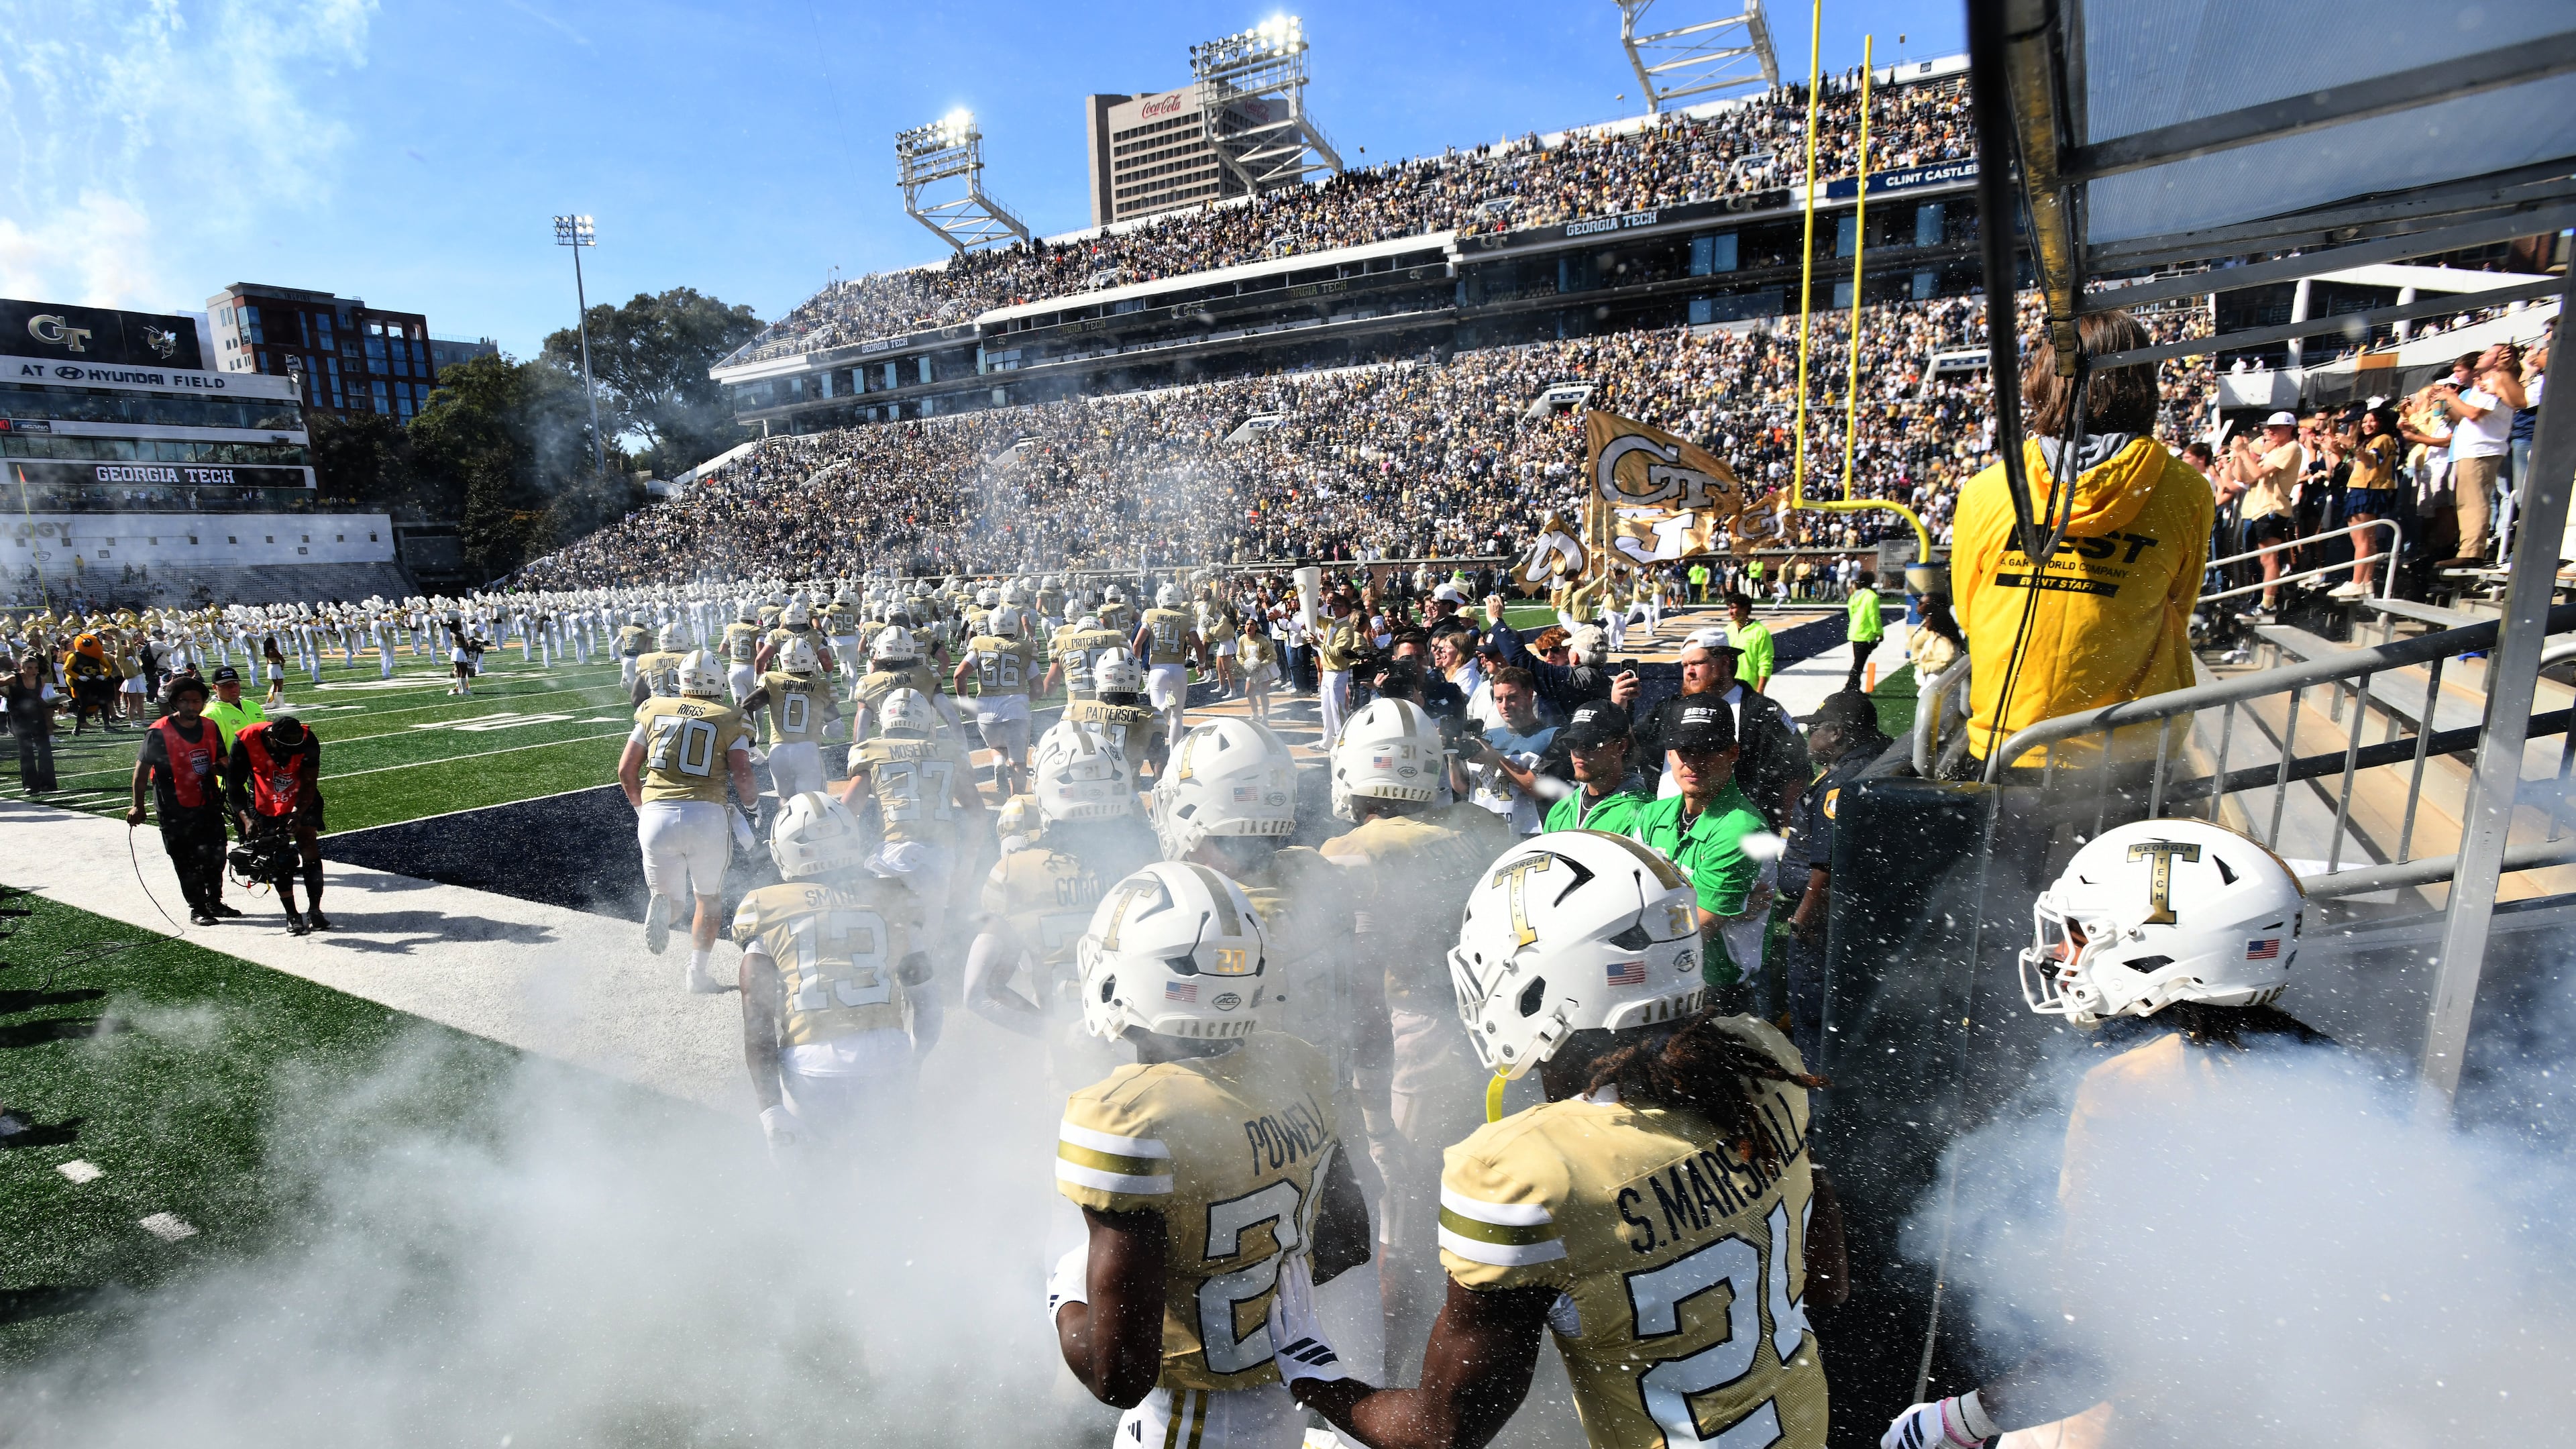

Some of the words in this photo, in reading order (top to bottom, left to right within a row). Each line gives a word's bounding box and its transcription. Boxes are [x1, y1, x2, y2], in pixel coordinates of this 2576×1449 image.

[1886, 172, 1922, 187] CLINT
[1566, 217, 1619, 237] GEORGIA
[1623, 211, 1658, 228] TECH
[1322, 281, 1347, 293] TECH
[1085, 319, 1106, 330] TECH
[862, 343, 888, 354] GEORGIA
[890, 337, 908, 347] TECH
[21, 364, 44, 377] AT
[88, 369, 164, 385] HYUNDAI
[173, 375, 225, 388] FIELD
[96, 466, 179, 483] GEORGIA
[184, 468, 235, 484] TECH
[2079, 563, 2129, 579] COMPANY
[2058, 580, 2097, 591] STAFF
[833, 614, 854, 631] 69
[1111, 611, 1131, 631] 15
[1152, 622, 1180, 653] 14
[731, 636, 752, 659] 16
[980, 651, 1020, 687] 66
[678, 704, 706, 723] RIGGS
[1085, 706, 1139, 722] PATTERSON
[1684, 707, 1717, 716] BEST
[891, 720, 920, 729] JACKETS
[649, 715, 718, 777] 70
[889, 743, 939, 759] MOSELEY
[879, 761, 953, 821] 37
[1373, 786, 1432, 800] JACKETS
[1498, 857, 1545, 876] GEORGIA
[2156, 858, 2165, 900] TECH
[1513, 875, 1522, 920] TECH
[788, 911, 892, 1012] 13
[1217, 949, 1245, 973] 20
[1196, 1140, 1336, 1375] 2
